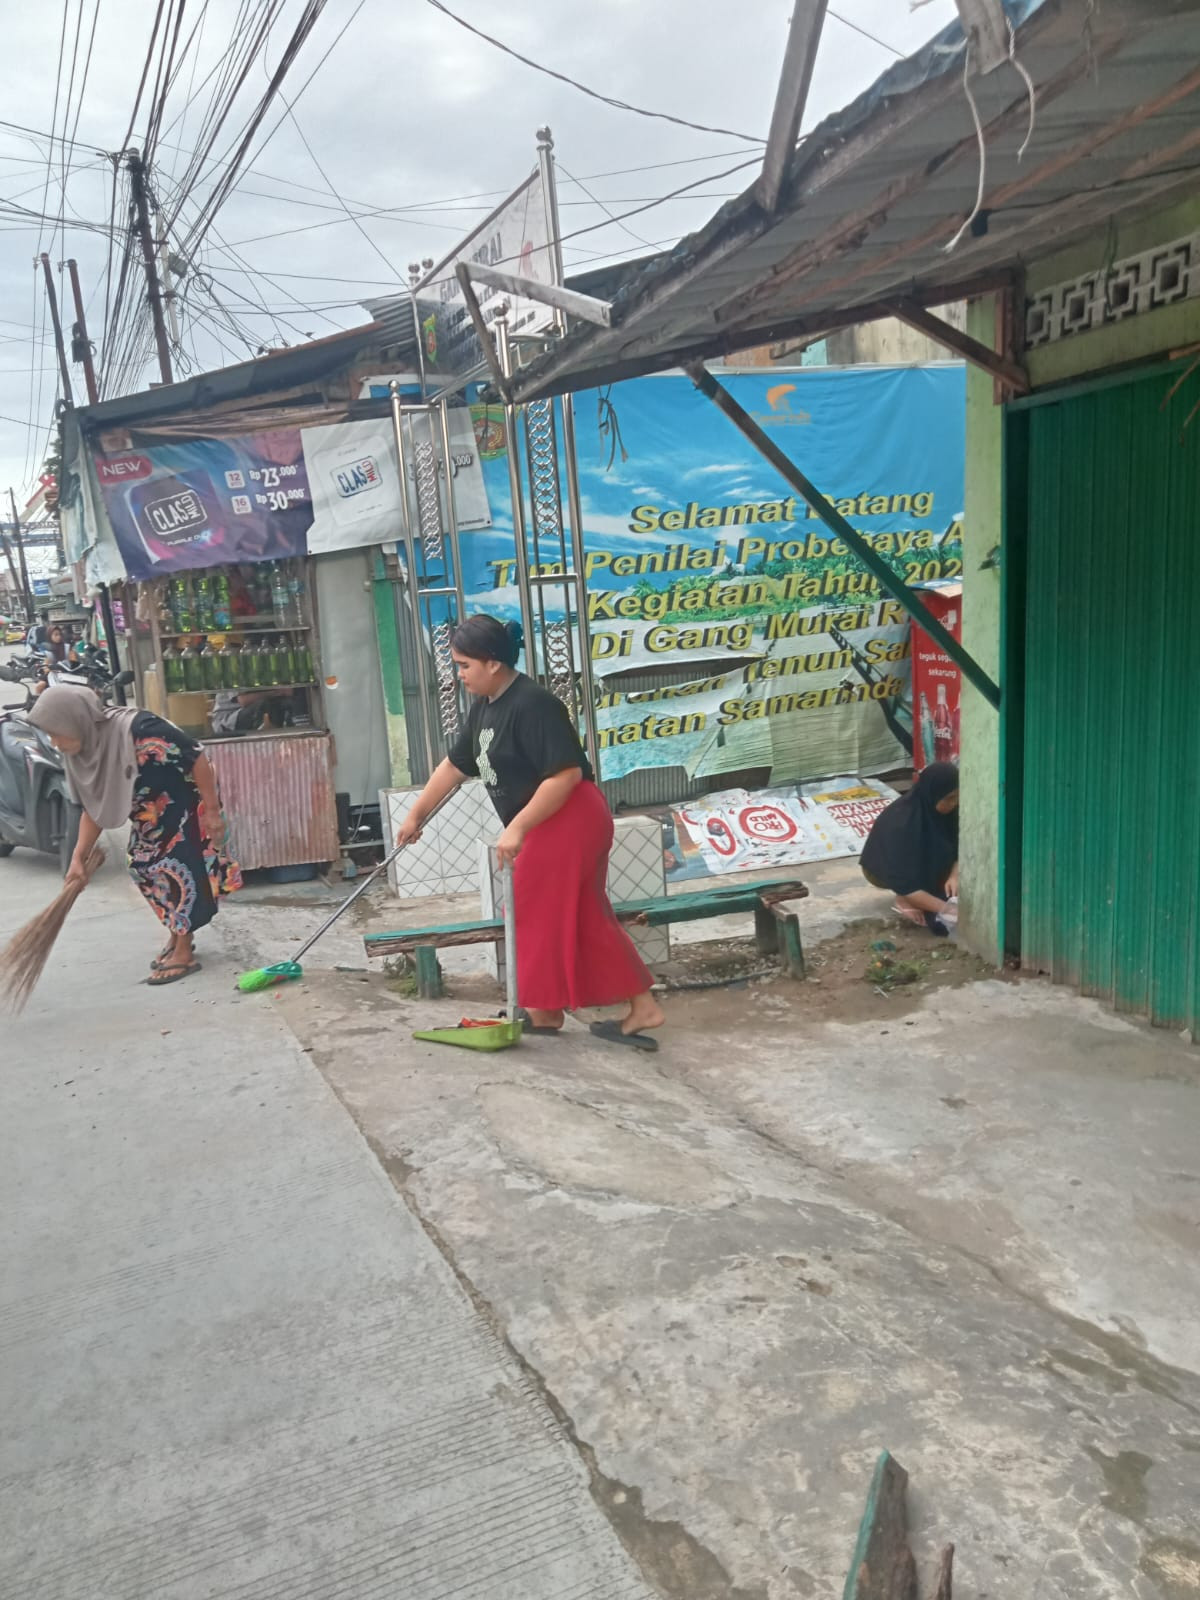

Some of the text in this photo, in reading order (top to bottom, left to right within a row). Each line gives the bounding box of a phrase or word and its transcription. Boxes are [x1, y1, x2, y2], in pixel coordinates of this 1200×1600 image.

[102, 461, 141, 476] NEW
[229, 472, 241, 481] 12
[337, 466, 368, 494] CLAS
[362, 460, 377, 483] MILD
[152, 501, 190, 531] CLAS
[181, 495, 201, 520] MILD
[234, 498, 247, 508] 16
[629, 496, 797, 534] Selamat
[487, 557, 565, 588] Tm
[584, 539, 727, 579] Penilai
[588, 581, 768, 620] Kegiatan
[590, 629, 634, 661] Di
[643, 622, 754, 653] Gang
[763, 603, 872, 641] Murai
[754, 820, 784, 831] PRO
